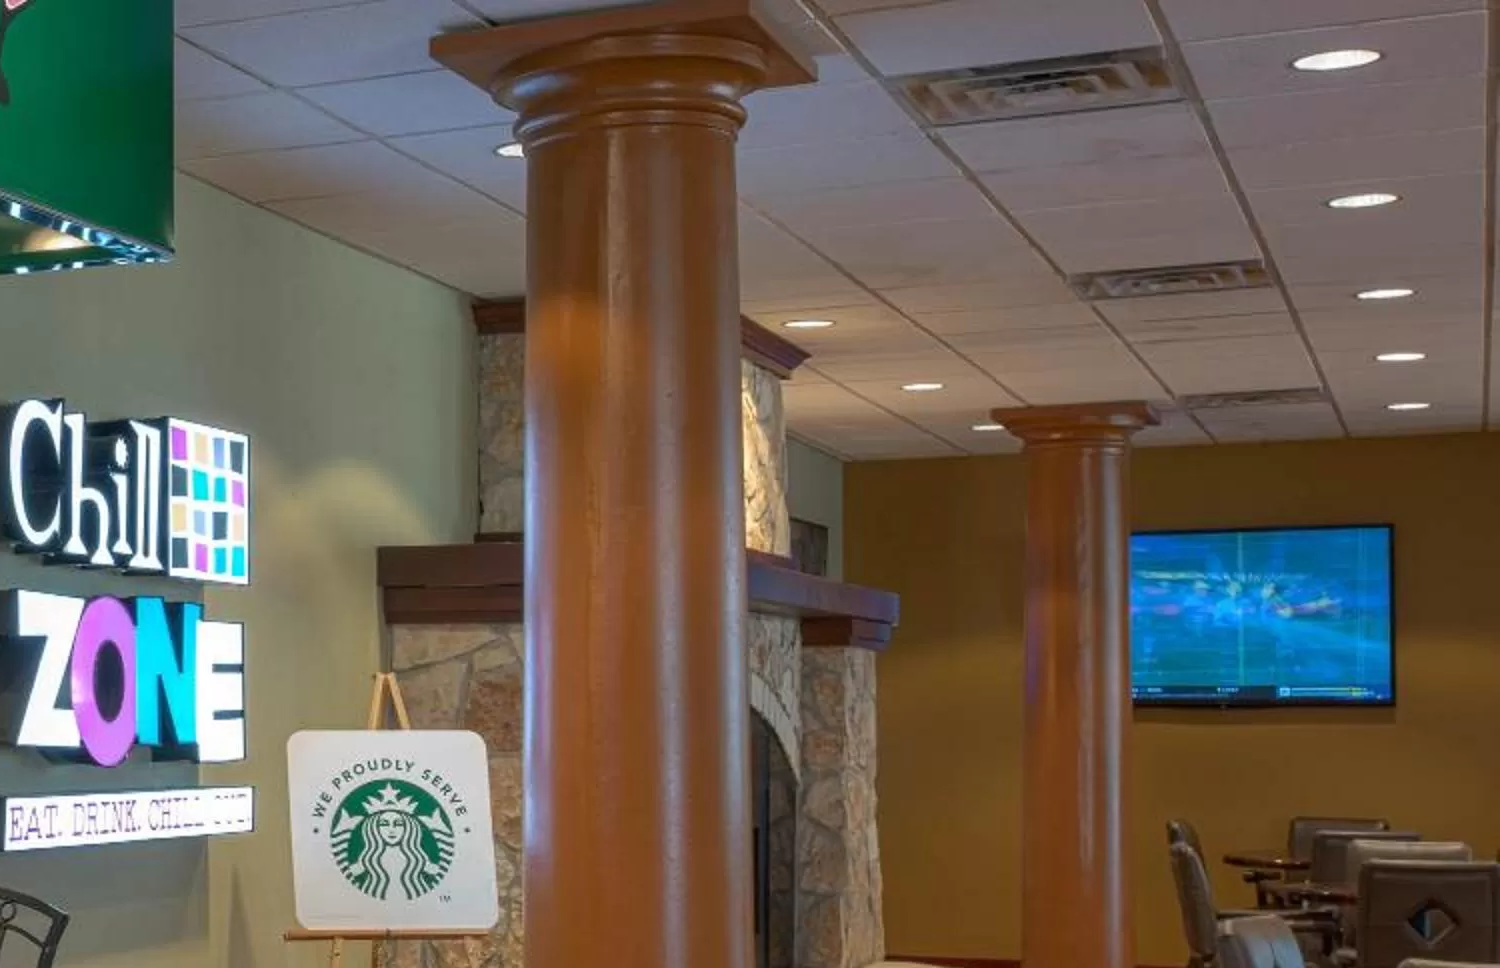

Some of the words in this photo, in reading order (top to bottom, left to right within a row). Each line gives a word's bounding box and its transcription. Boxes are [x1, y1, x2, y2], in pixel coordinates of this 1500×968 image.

[9, 399, 165, 571] Chill
[16, 589, 246, 768] ZONE
[8, 804, 63, 842] EAT.
[72, 798, 142, 837] DRINK.
[312, 791, 333, 818] WE
[332, 758, 416, 791] PROUDLY
[421, 769, 468, 817] SERVE
